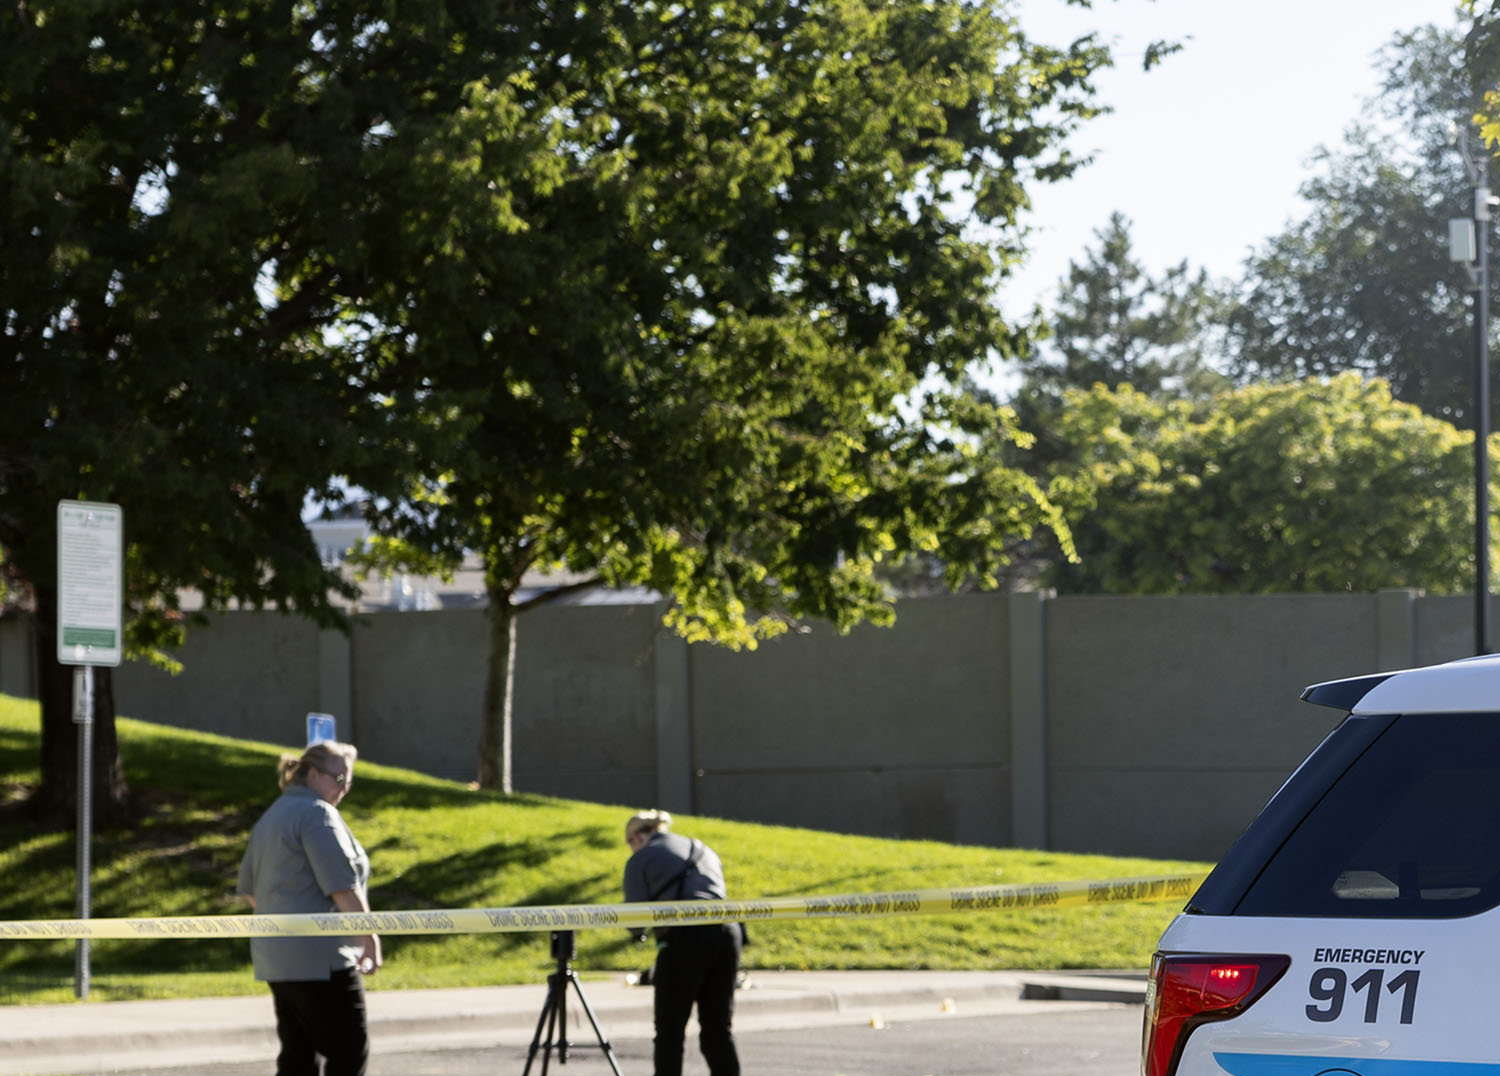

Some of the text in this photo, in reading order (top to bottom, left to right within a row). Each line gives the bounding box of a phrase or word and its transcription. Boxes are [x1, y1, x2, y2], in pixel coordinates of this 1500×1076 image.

[342, 914, 383, 930] SCENE
[376, 914, 398, 930] DO
[393, 913, 418, 930] NOT
[415, 912, 454, 929] CROSS
[514, 909, 551, 927] SCENE
[546, 908, 565, 926] DO
[563, 908, 584, 926] NOT
[582, 907, 618, 925] CROSS
[1313, 948, 1425, 965] EMERGENCY
[1305, 967, 1421, 1024] 911
